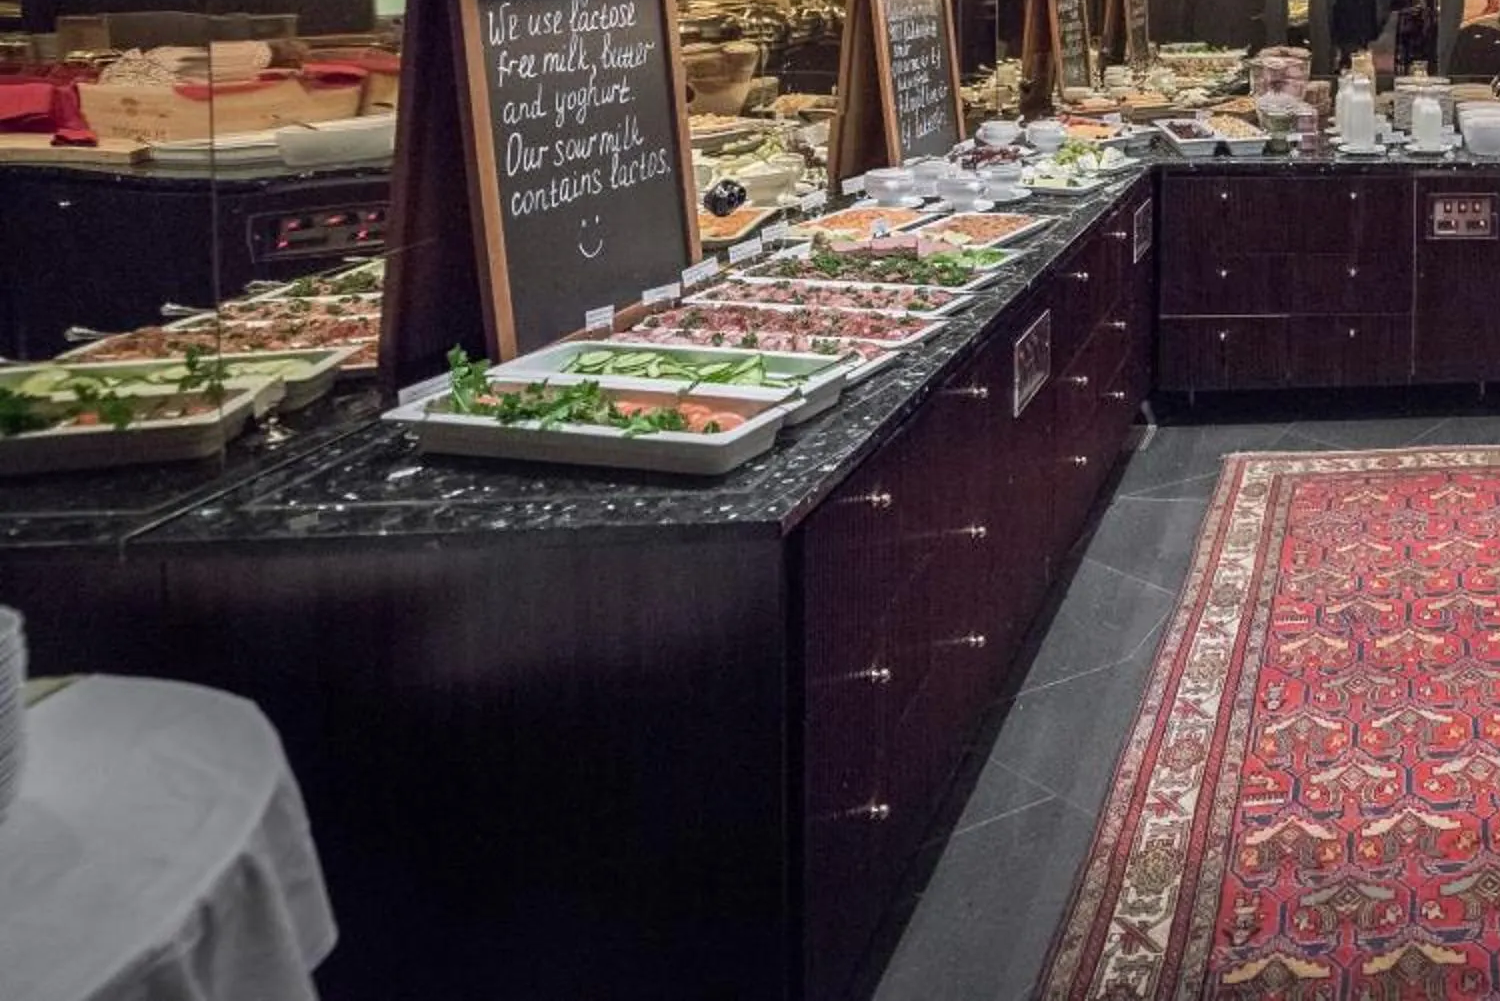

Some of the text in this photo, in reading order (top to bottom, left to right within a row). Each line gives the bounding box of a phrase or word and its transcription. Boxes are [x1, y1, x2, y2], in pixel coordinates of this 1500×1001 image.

[488, 2, 519, 46] We
[527, 10, 563, 36] use
[497, 32, 655, 87] free milk, butter
[503, 75, 636, 128] and yoghurt.
[506, 132, 549, 177] Our
[511, 148, 672, 216] contains lactos.
